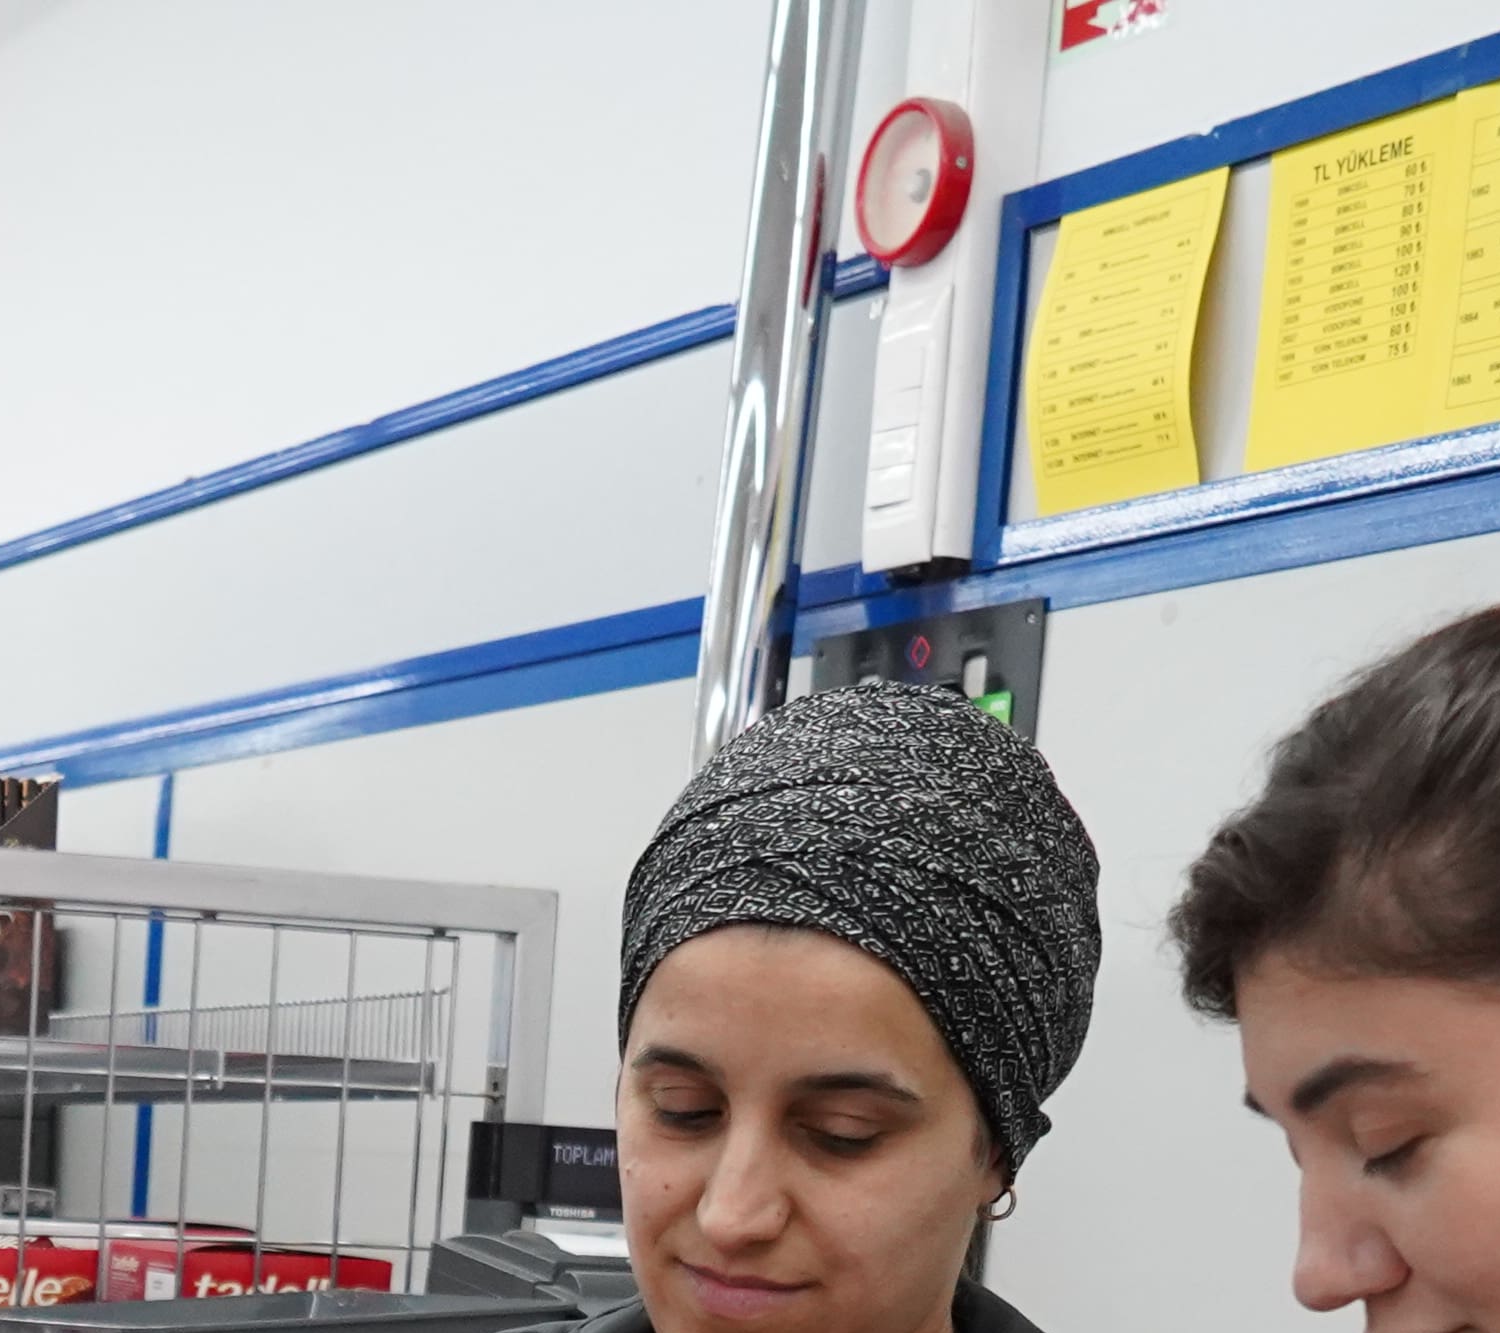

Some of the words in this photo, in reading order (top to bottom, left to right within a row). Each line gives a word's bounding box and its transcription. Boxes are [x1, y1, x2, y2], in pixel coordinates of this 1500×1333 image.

[1314, 165, 1331, 184] TL
[1337, 136, 1414, 176] YÜKLEME
[553, 1144, 615, 1167] TOPLAM
[550, 1207, 596, 1219] TOSHIBA
